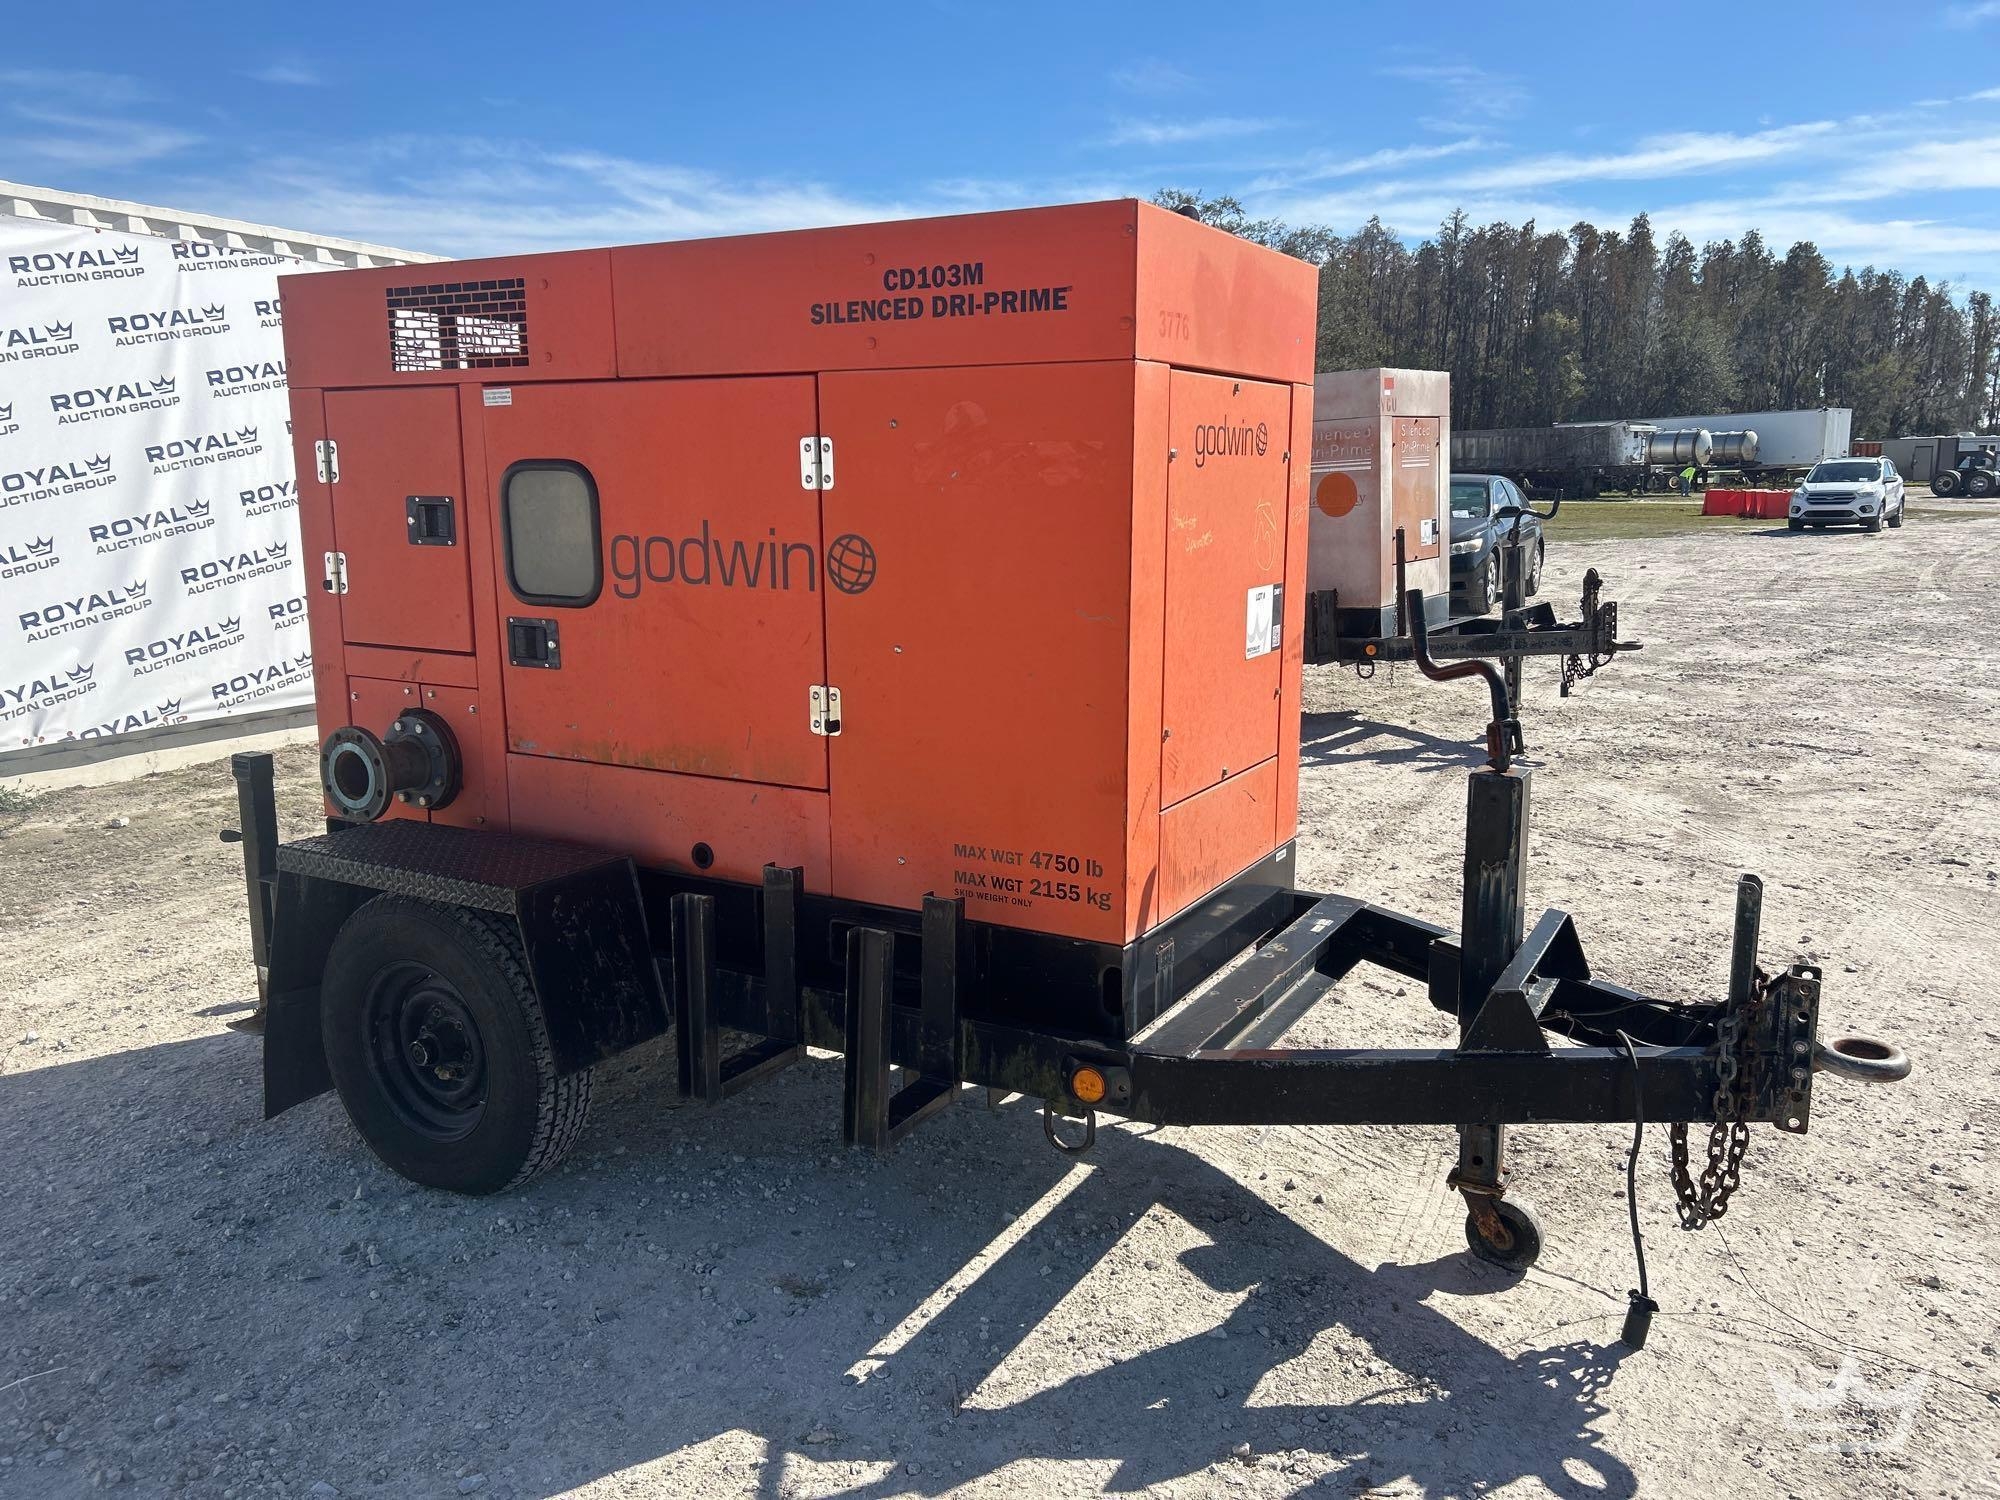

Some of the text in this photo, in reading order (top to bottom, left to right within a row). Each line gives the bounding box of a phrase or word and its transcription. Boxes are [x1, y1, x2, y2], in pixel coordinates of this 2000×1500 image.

[8, 250, 115, 273] ROYAL
[178, 256, 285, 272] AUCTION GROUP
[17, 267, 144, 288] AUCTION GROUP
[883, 263, 984, 292] CD103M
[108, 308, 204, 334] ROYAL
[810, 297, 924, 325] SILENCED
[115, 324, 230, 347] AUCTION GROUP
[22, 343, 80, 360] GROUP
[50, 382, 152, 412] ROYAL
[213, 381, 271, 398] AUCTION
[58, 396, 180, 425] AUCTION GROUP
[145, 433, 238, 462] ROYAL
[1195, 414, 1254, 468] godwin
[153, 445, 262, 475] AUCTION GROUP
[62, 475, 117, 494] GROUP
[88, 508, 187, 542] ROYAL
[96, 518, 215, 555] AUCTION GROUP
[2, 557, 60, 578] GROUP
[180, 550, 267, 584] ROYAL
[611, 520, 816, 599] godwin
[188, 560, 292, 596] AUCTION GROUP
[19, 590, 126, 630] ROYAL
[27, 598, 152, 643] AUCTION GROUP
[124, 626, 220, 666] ROYAL
[134, 634, 245, 678] AUCTION GROUP
[42, 682, 96, 707] GROUP
[211, 660, 296, 700] ROYAL
[216, 684, 276, 710] AUCTION
[954, 844, 1103, 878] MAX WGT 4750 lb
[954, 870, 1112, 912] MAX WGT 2155 kg
[954, 888, 1032, 908] SKID WEIGHT ONLY
